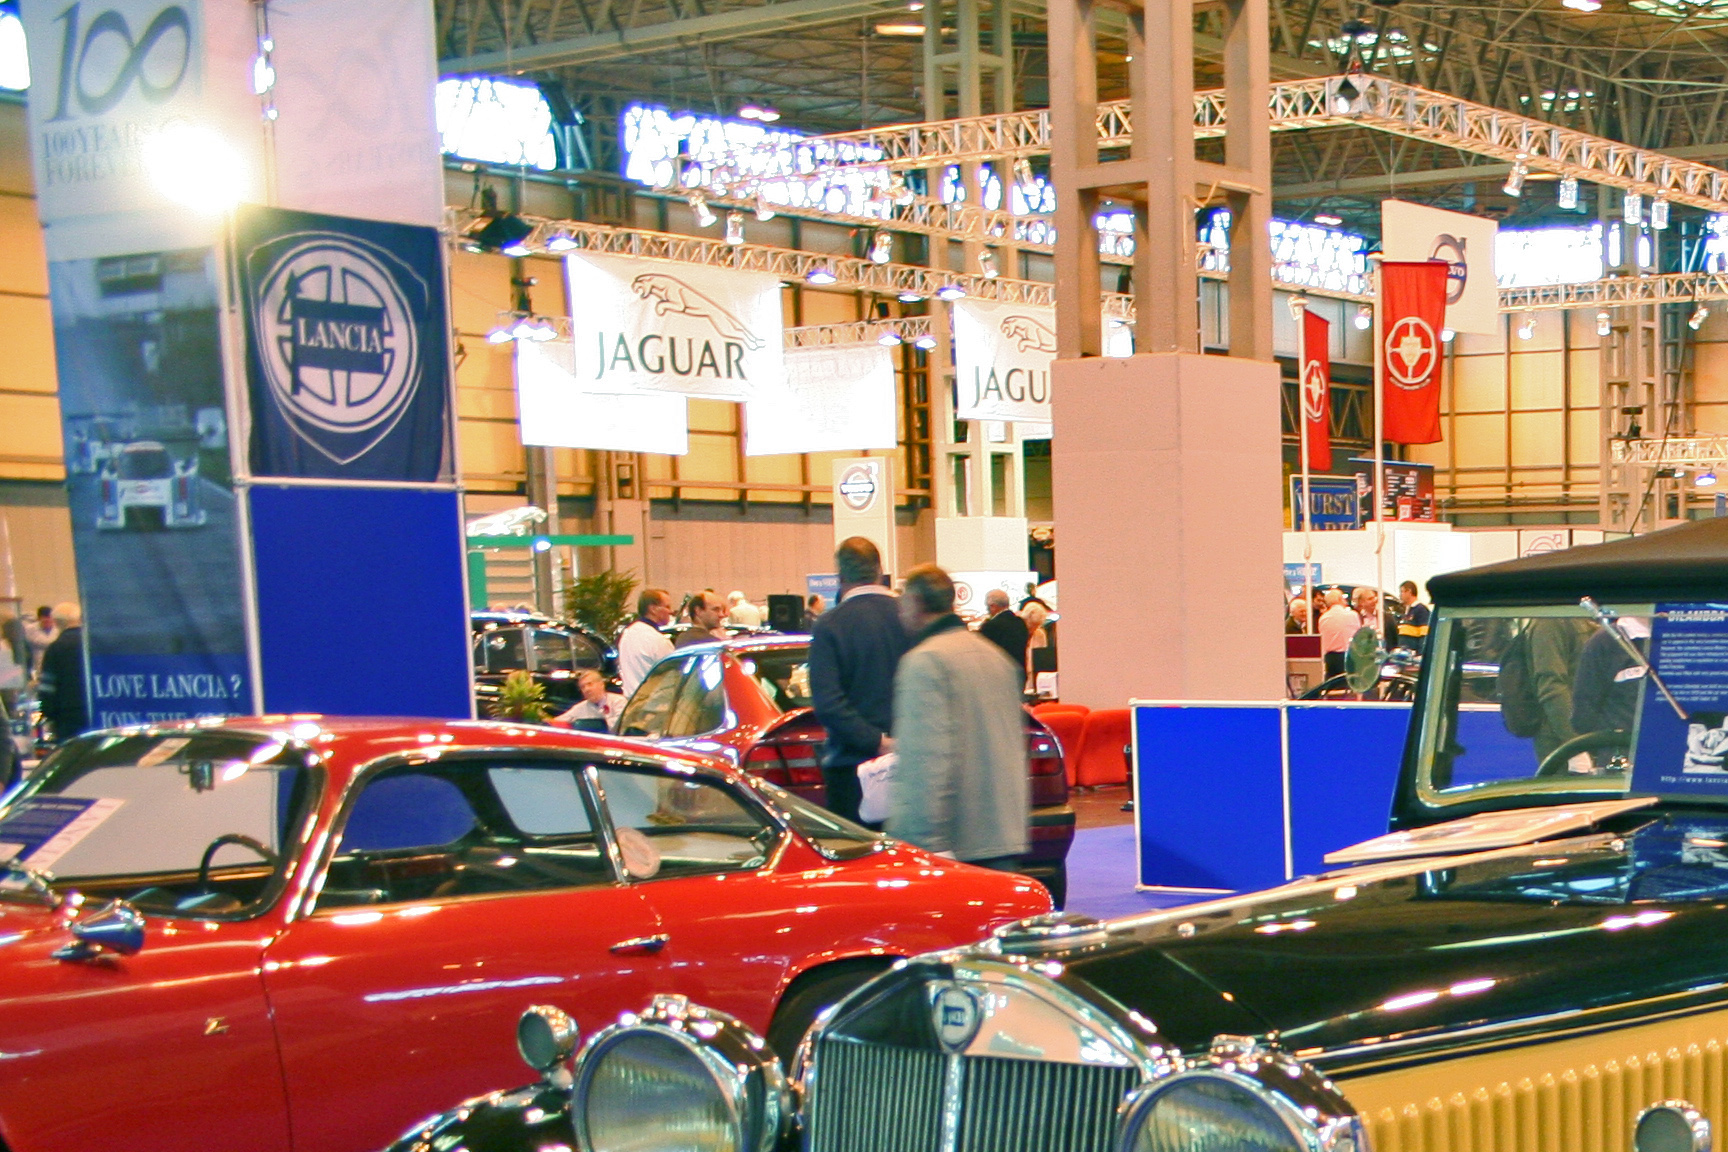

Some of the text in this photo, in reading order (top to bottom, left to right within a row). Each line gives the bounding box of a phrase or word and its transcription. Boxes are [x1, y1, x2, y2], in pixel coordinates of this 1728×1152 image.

[46, 3, 191, 122] 100
[298, 317, 382, 353] LANCIA
[595, 331, 747, 380] JAGUAR
[971, 365, 1052, 408] JAGU
[94, 674, 147, 698] LOVE
[151, 674, 228, 698] LANCIA
